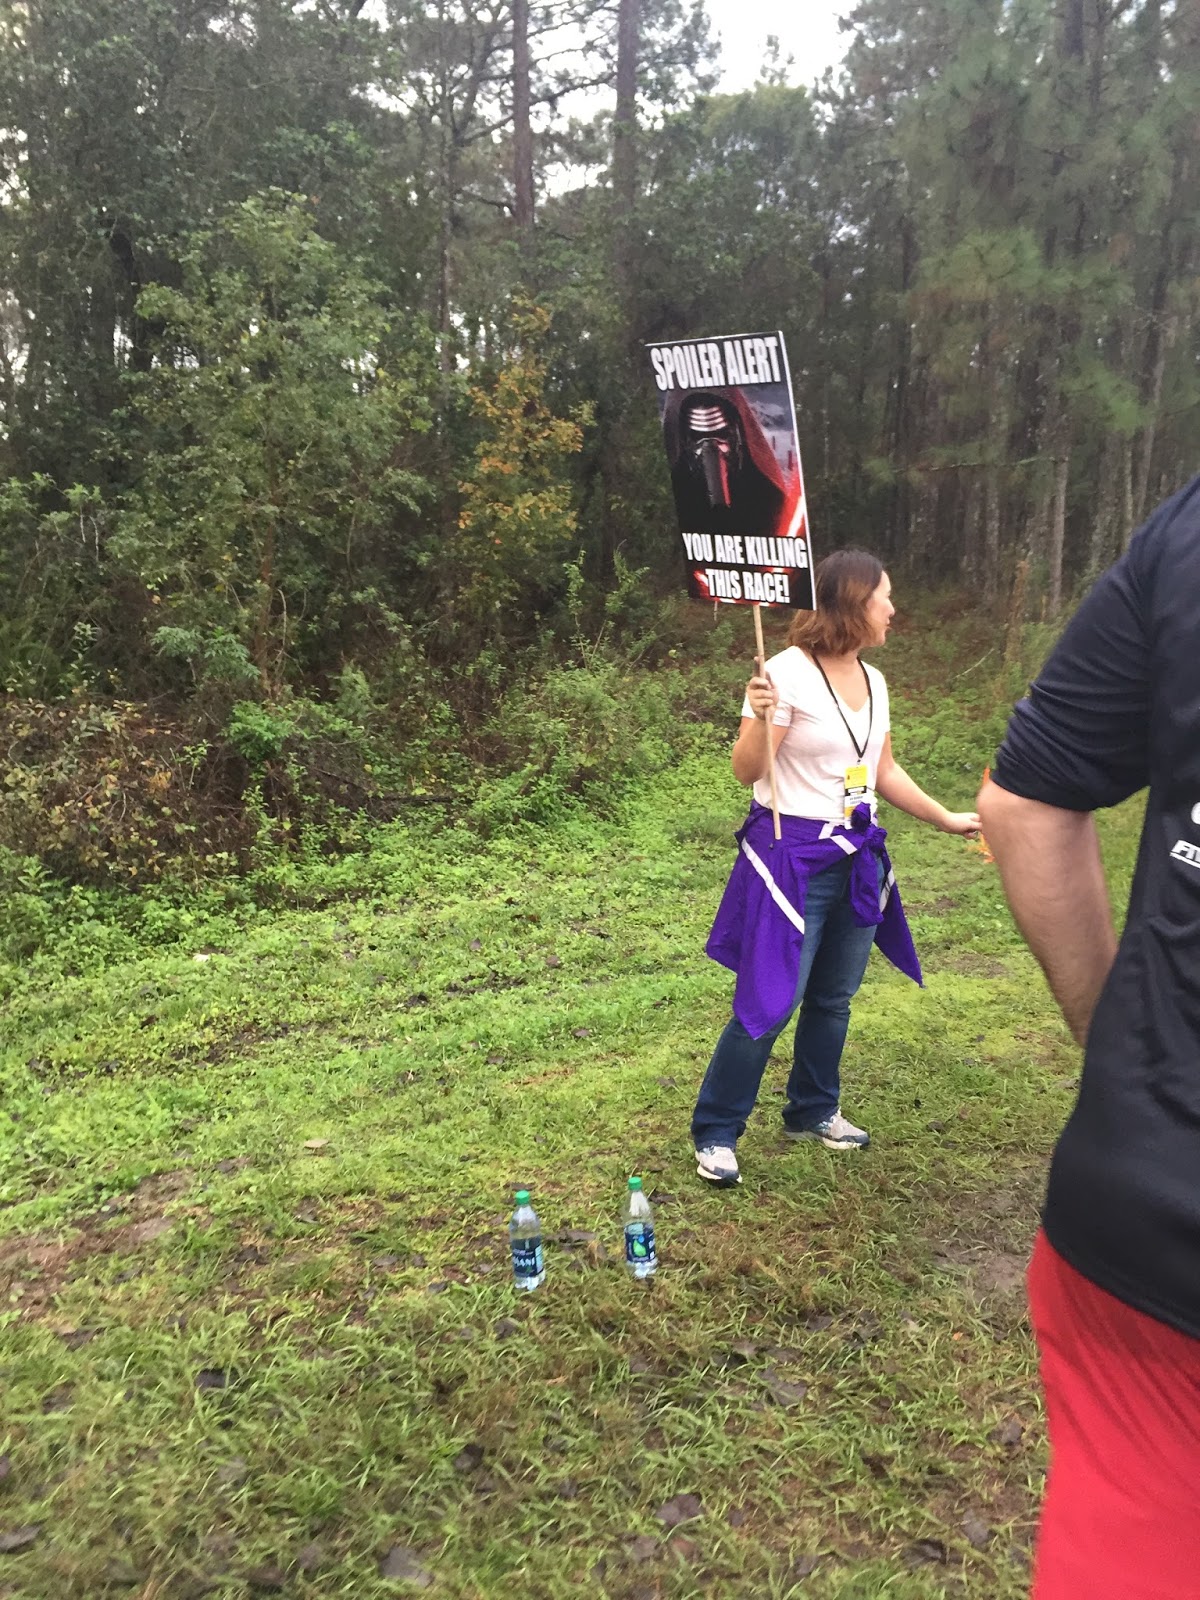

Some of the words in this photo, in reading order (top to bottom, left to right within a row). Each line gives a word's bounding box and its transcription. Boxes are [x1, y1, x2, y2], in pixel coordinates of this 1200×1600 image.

[650, 342, 726, 391] SPOILER
[723, 336, 781, 386] ALERT
[682, 532, 713, 563] YOU
[715, 534, 745, 564] ARE
[744, 536, 808, 569] KILLING
[705, 569, 741, 600] THIS
[742, 571, 791, 604] RACE!
